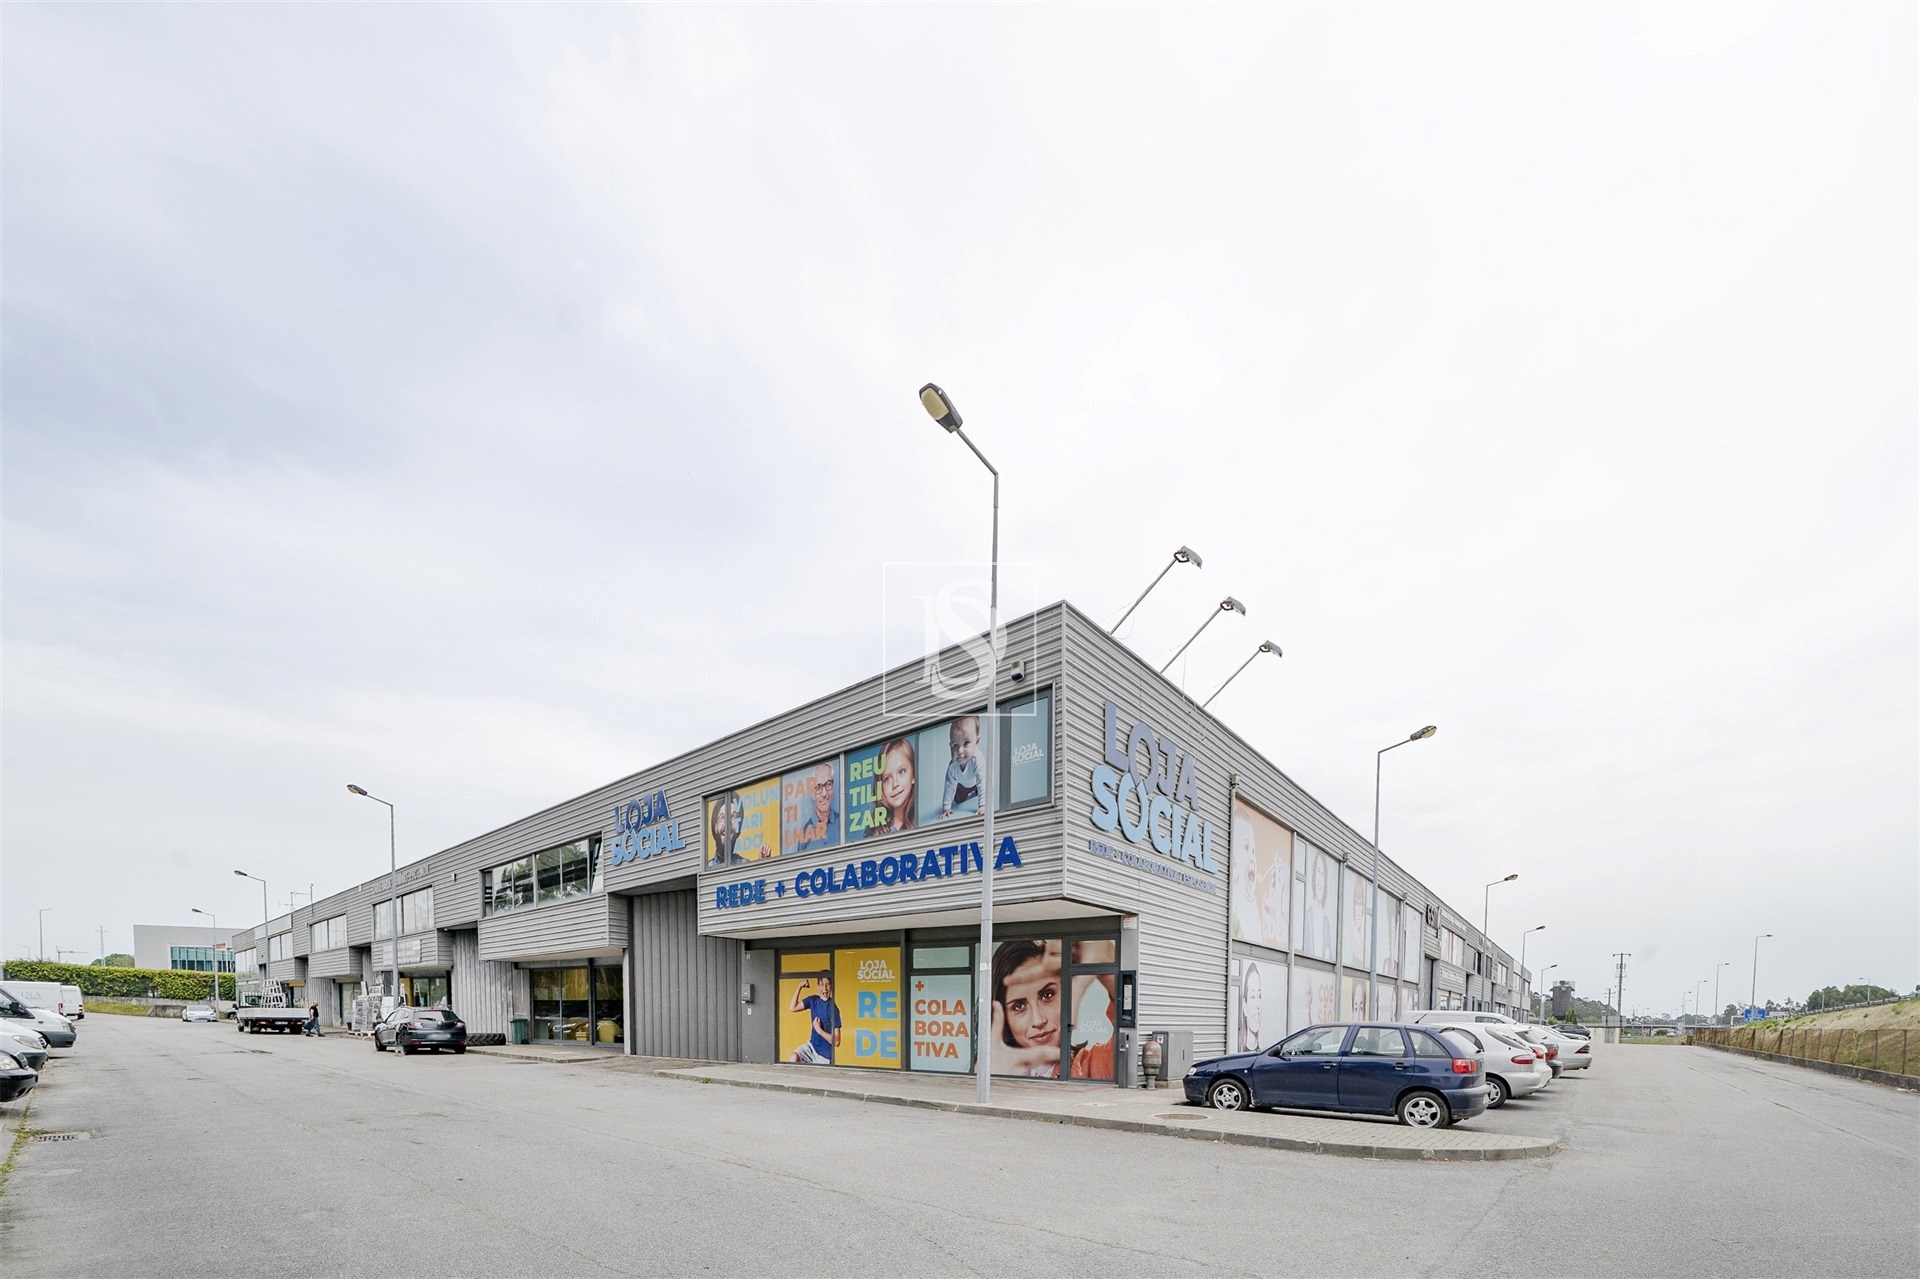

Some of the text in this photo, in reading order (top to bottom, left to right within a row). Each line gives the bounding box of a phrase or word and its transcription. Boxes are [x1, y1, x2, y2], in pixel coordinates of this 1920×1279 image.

[1012, 749, 1045, 764] SOCIAL
[1014, 742, 1038, 755] LOJA
[1104, 700, 1199, 811] LOJA
[849, 753, 887, 782] REU
[784, 776, 817, 801] PAR
[849, 780, 883, 807] TILI
[614, 787, 671, 834] LOJA
[784, 805, 798, 824] TI
[849, 807, 888, 832] ZAR
[1090, 764, 1219, 875] SOCIAL
[611, 819, 687, 866] SOCIAL
[784, 820, 828, 848] LHAR
[716, 878, 767, 910] REDE
[795, 836, 1024, 898] COLABORATIVA
[857, 969, 896, 980] SOCIAL
[860, 960, 887, 971] LOJA
[857, 991, 898, 1019] RE
[914, 999, 967, 1016] COLA
[914, 1020, 969, 1038] BORA
[856, 1029, 898, 1058] DE
[914, 1041, 959, 1058] TIVA
